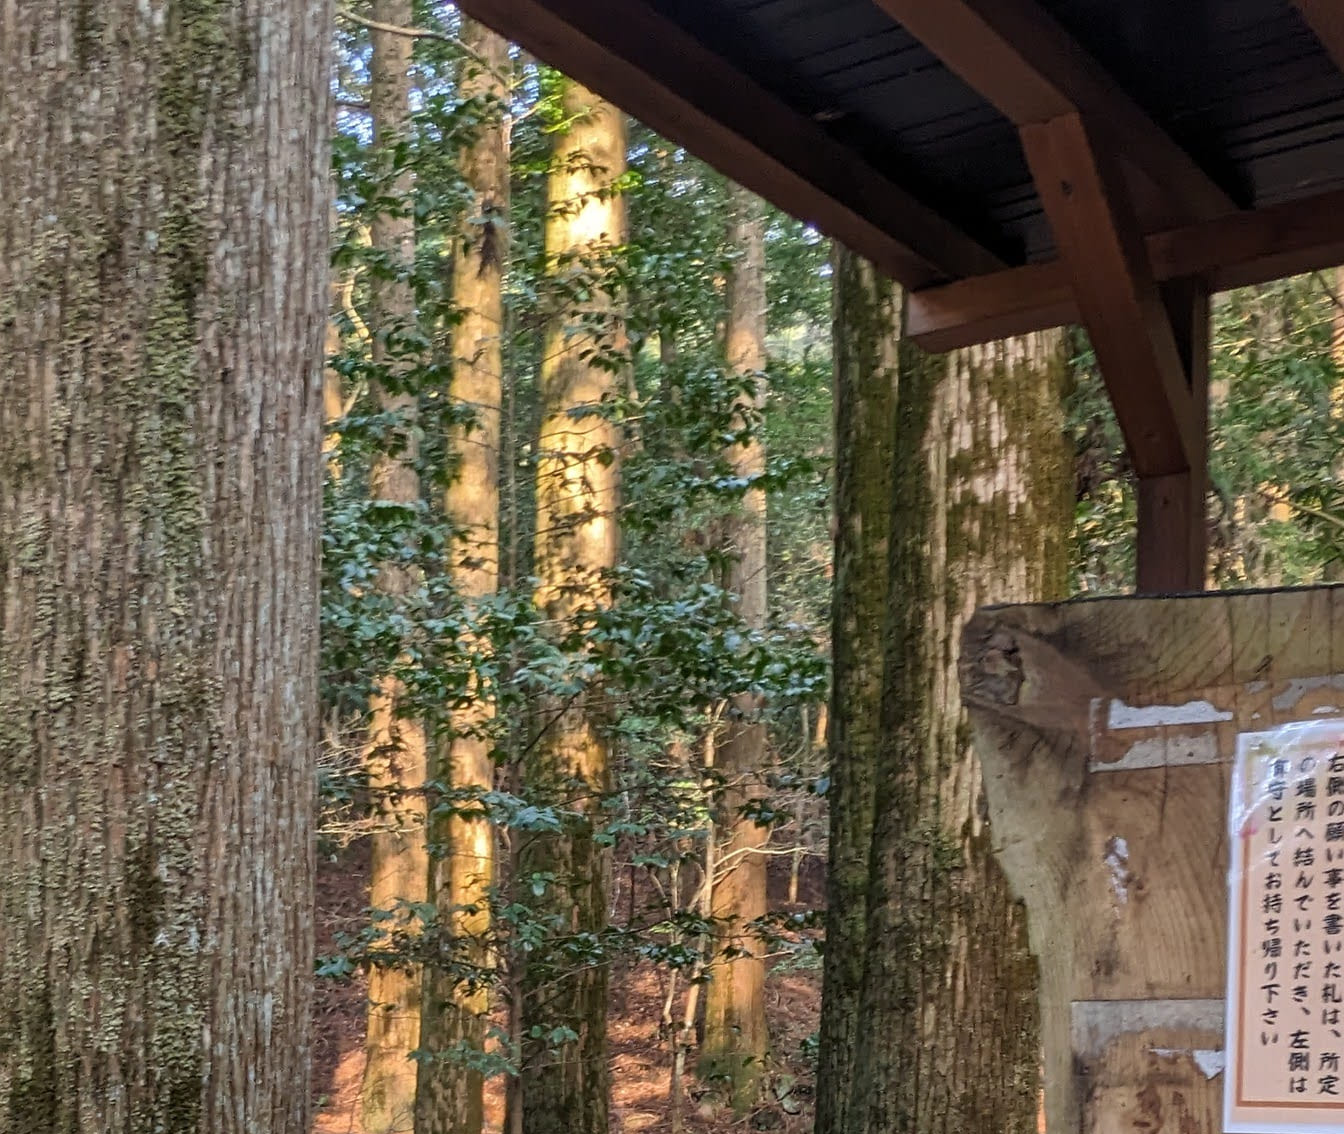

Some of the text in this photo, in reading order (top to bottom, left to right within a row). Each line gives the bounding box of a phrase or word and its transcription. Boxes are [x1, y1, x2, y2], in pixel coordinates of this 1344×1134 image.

[1288, 757, 1316, 1093] の場所へ結んでいただき、左側は
